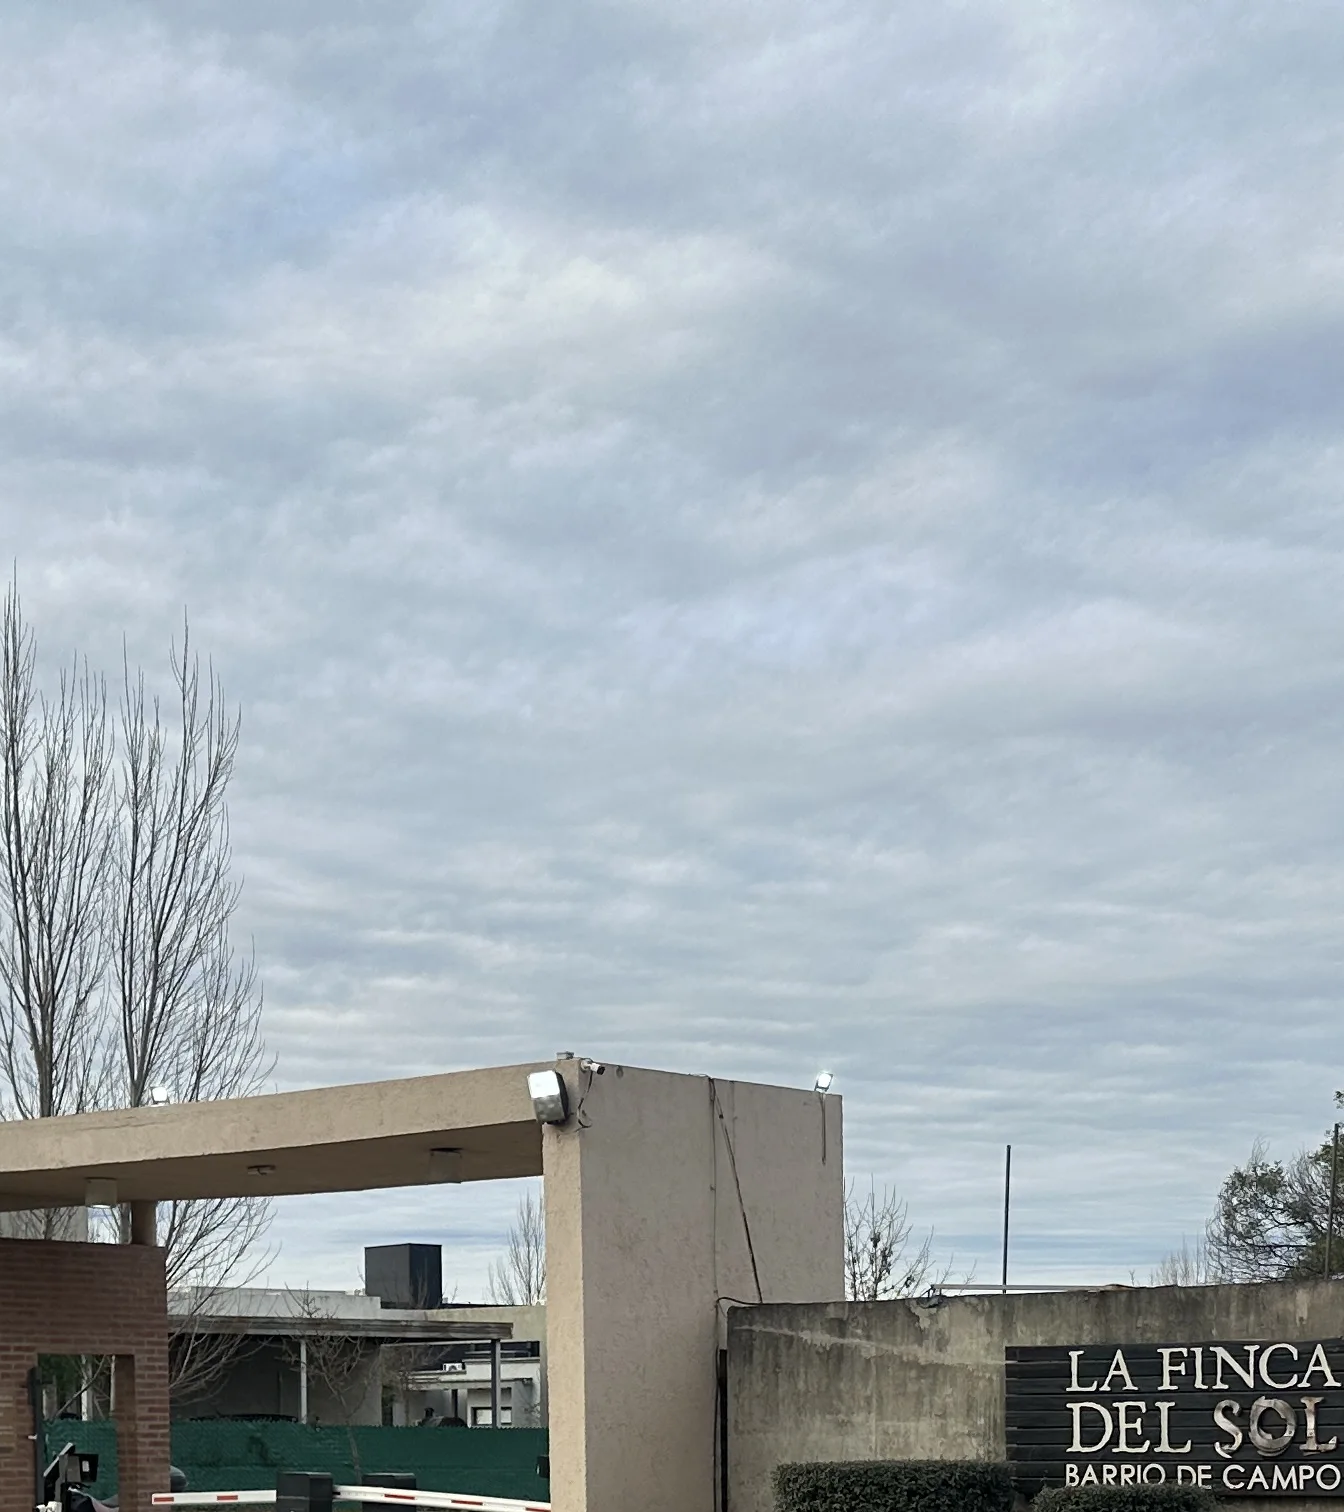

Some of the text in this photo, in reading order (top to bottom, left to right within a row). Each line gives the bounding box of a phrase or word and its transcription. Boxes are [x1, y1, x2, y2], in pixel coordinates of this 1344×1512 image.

[1065, 1343, 1343, 1392] LA FINCA
[1065, 1395, 1338, 1459] DEL SOL
[1065, 1463, 1342, 1491] BARRIO DE CAMPO
